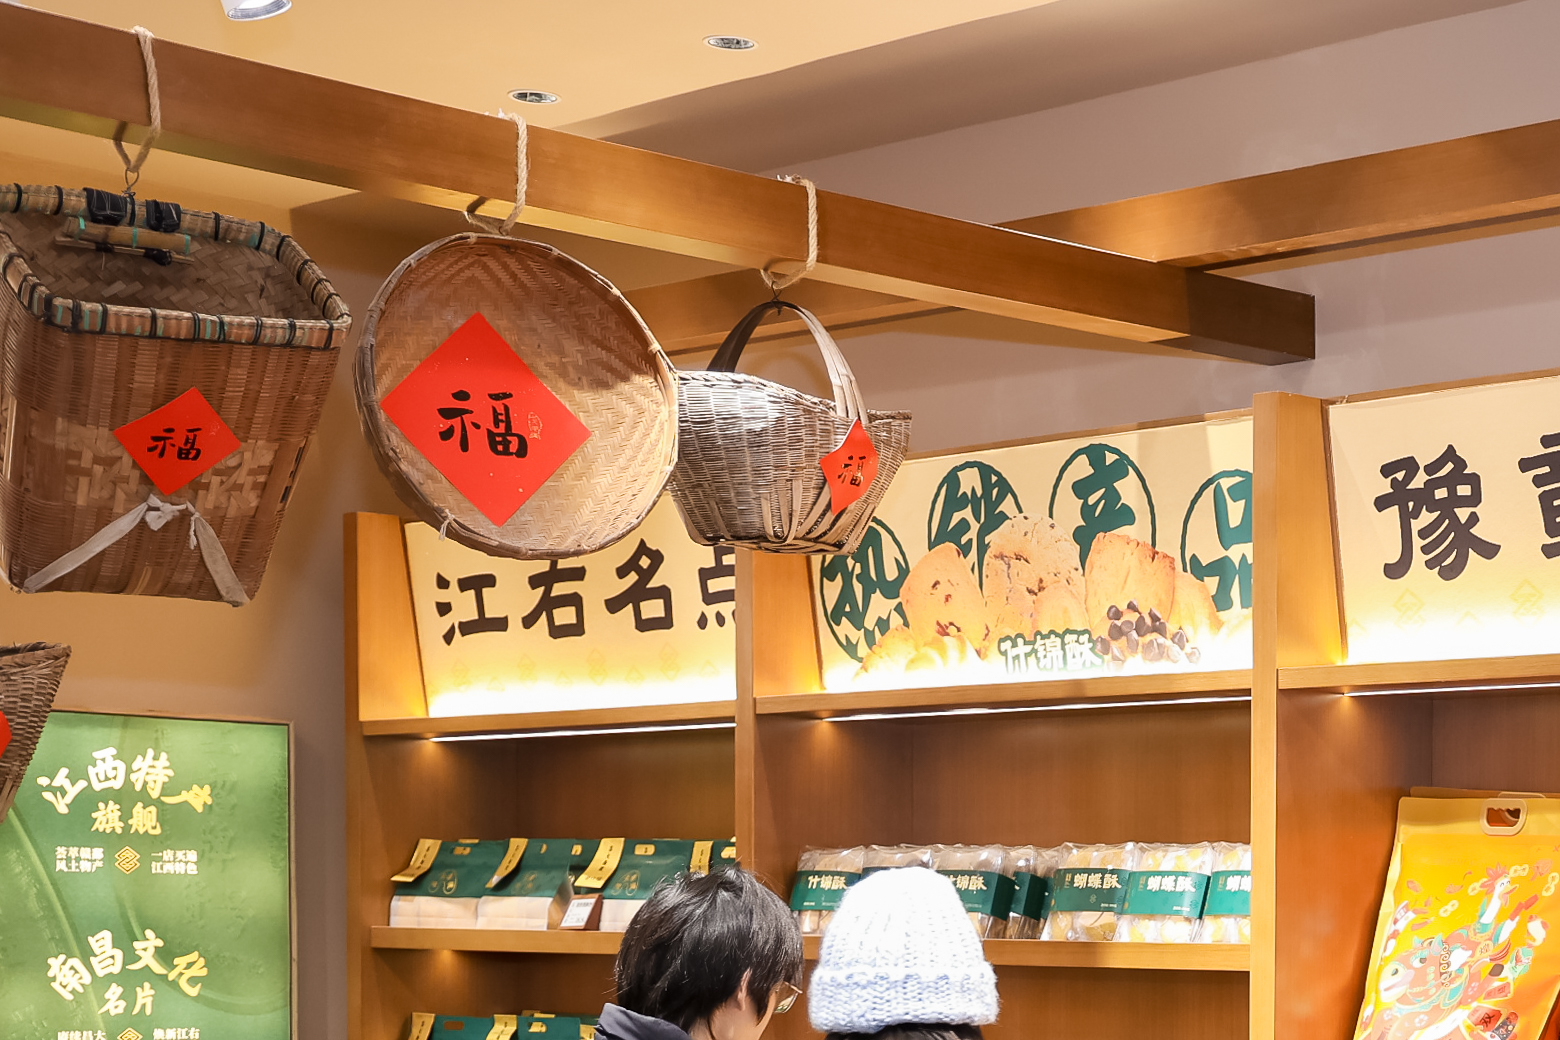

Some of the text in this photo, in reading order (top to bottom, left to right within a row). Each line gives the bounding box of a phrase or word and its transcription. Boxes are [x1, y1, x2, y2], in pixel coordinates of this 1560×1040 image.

[436, 389, 528, 460] 福
[146, 426, 203, 462] 福
[837, 454, 867, 489] 福
[435, 538, 736, 646] 江右名点
[1000, 631, 1103, 674] 什锦酥
[37, 747, 213, 815] 江西特产
[91, 801, 162, 836] 旗舰
[151, 862, 198, 875] 江西特色
[807, 874, 847, 891] 什锦酥
[1074, 872, 1122, 891] 蝴蝶酥
[1147, 874, 1196, 894] 蝴蝶酥
[47, 929, 208, 1000] 南昌文化
[99, 981, 156, 1016] 名片
